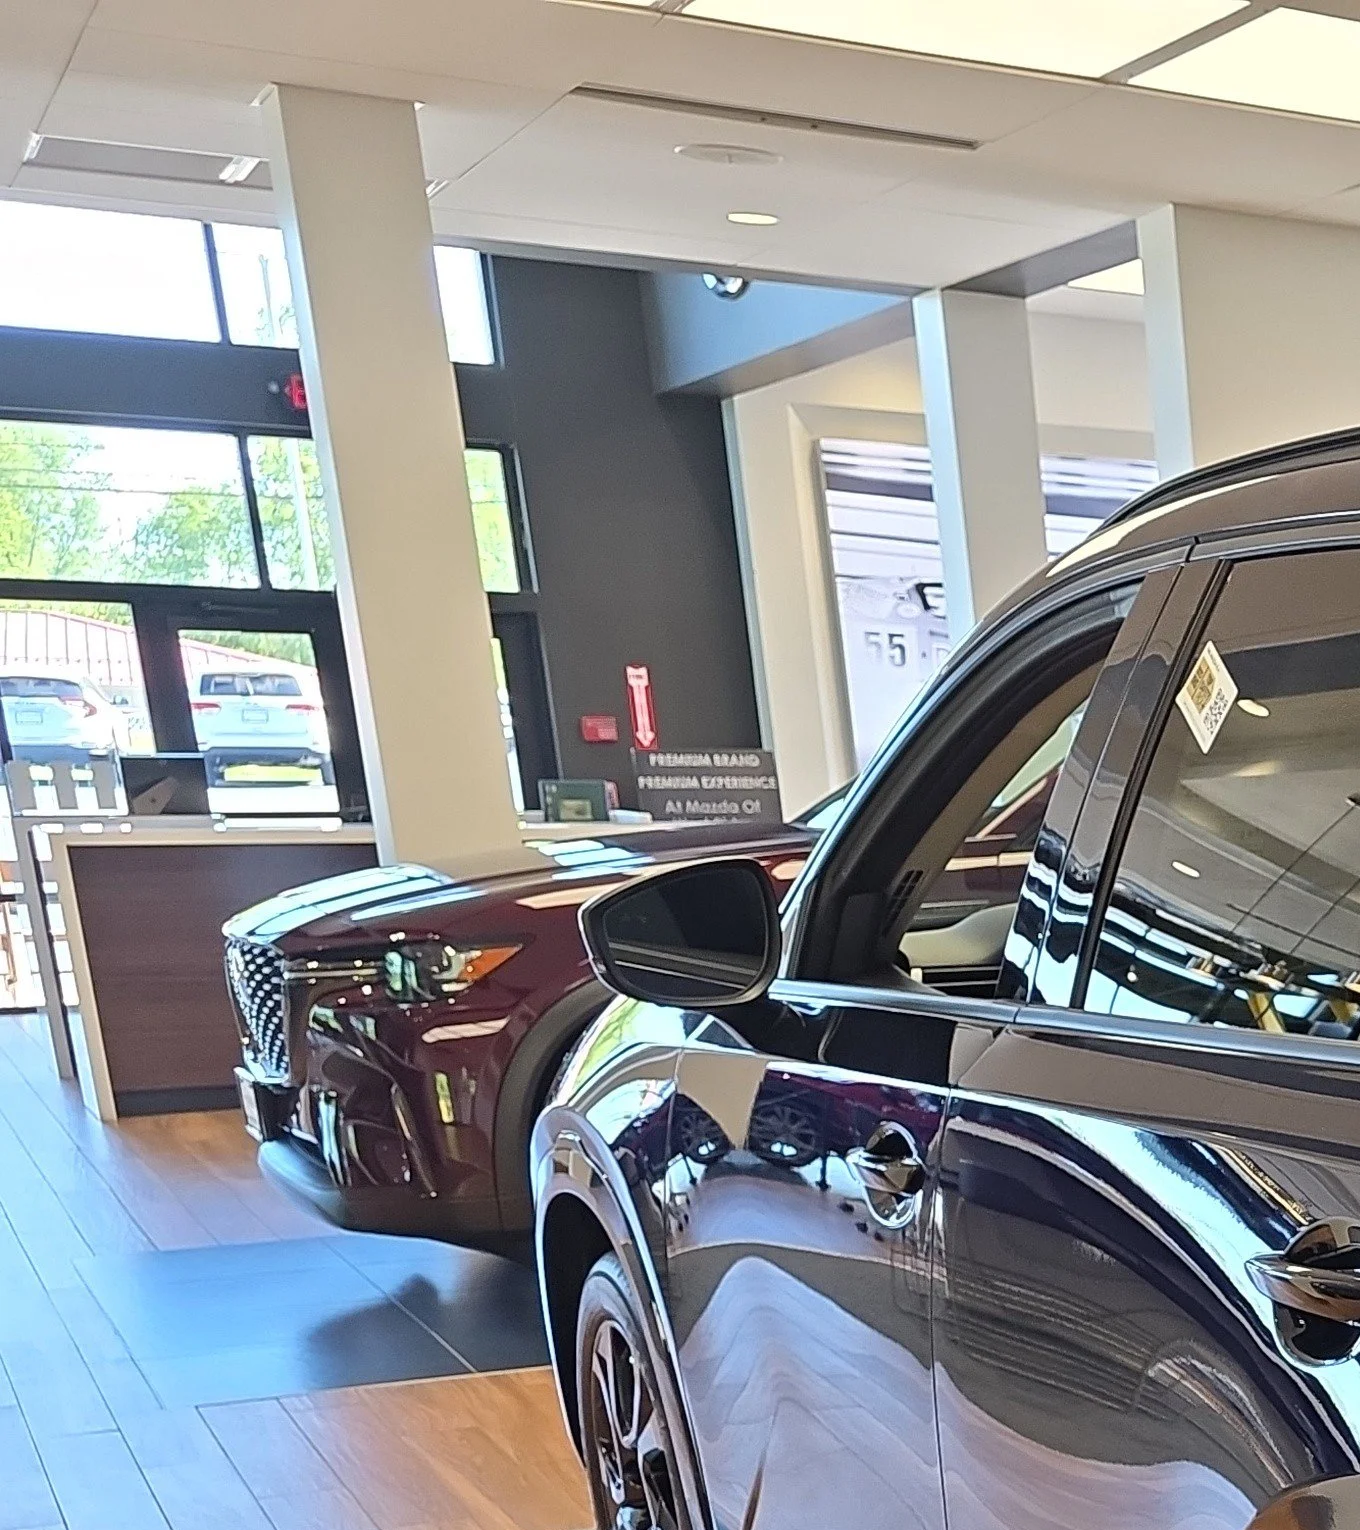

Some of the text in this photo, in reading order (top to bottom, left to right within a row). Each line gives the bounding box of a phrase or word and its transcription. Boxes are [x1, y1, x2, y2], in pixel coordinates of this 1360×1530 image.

[648, 753, 760, 767] PREMIUM BRAND
[638, 775, 778, 790] PREMIUM EXPERIENCE
[685, 799, 739, 814] Mazda
